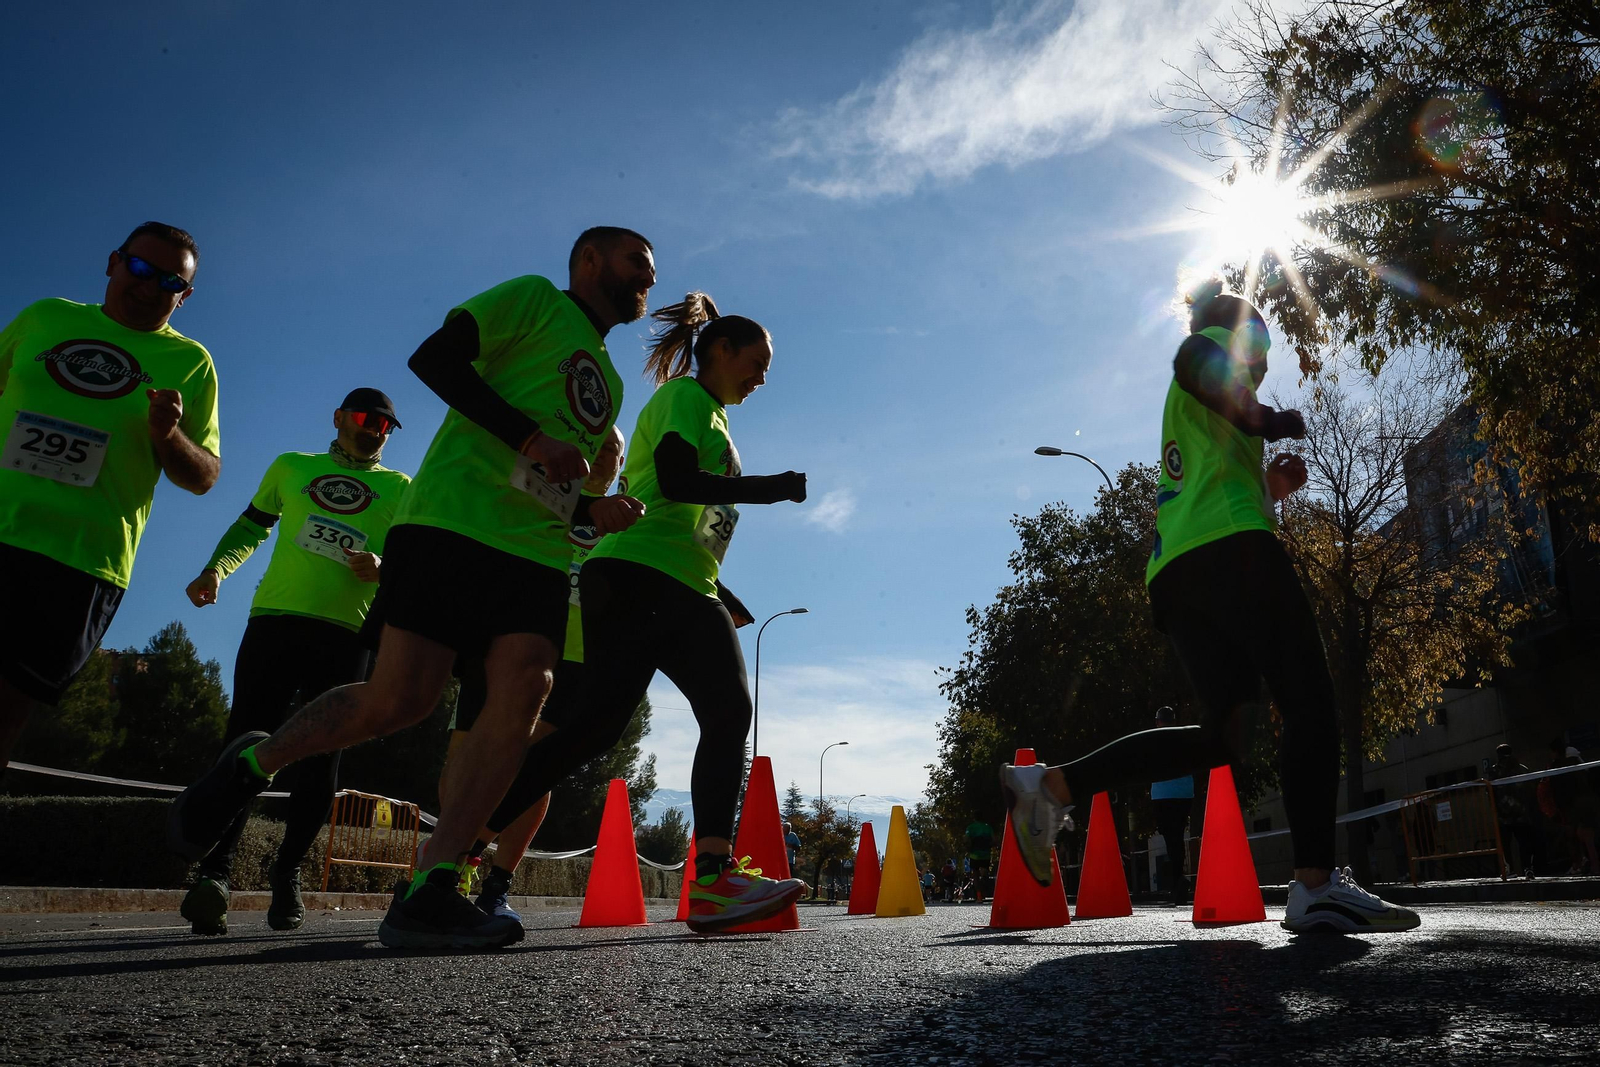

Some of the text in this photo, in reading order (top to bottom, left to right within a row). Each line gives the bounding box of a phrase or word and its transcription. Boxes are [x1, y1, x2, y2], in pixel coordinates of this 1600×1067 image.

[98, 362, 153, 384] Antonio
[20, 428, 90, 463] 295
[340, 487, 380, 499] Antonio
[309, 524, 354, 550] 330
[709, 511, 733, 541] 29
